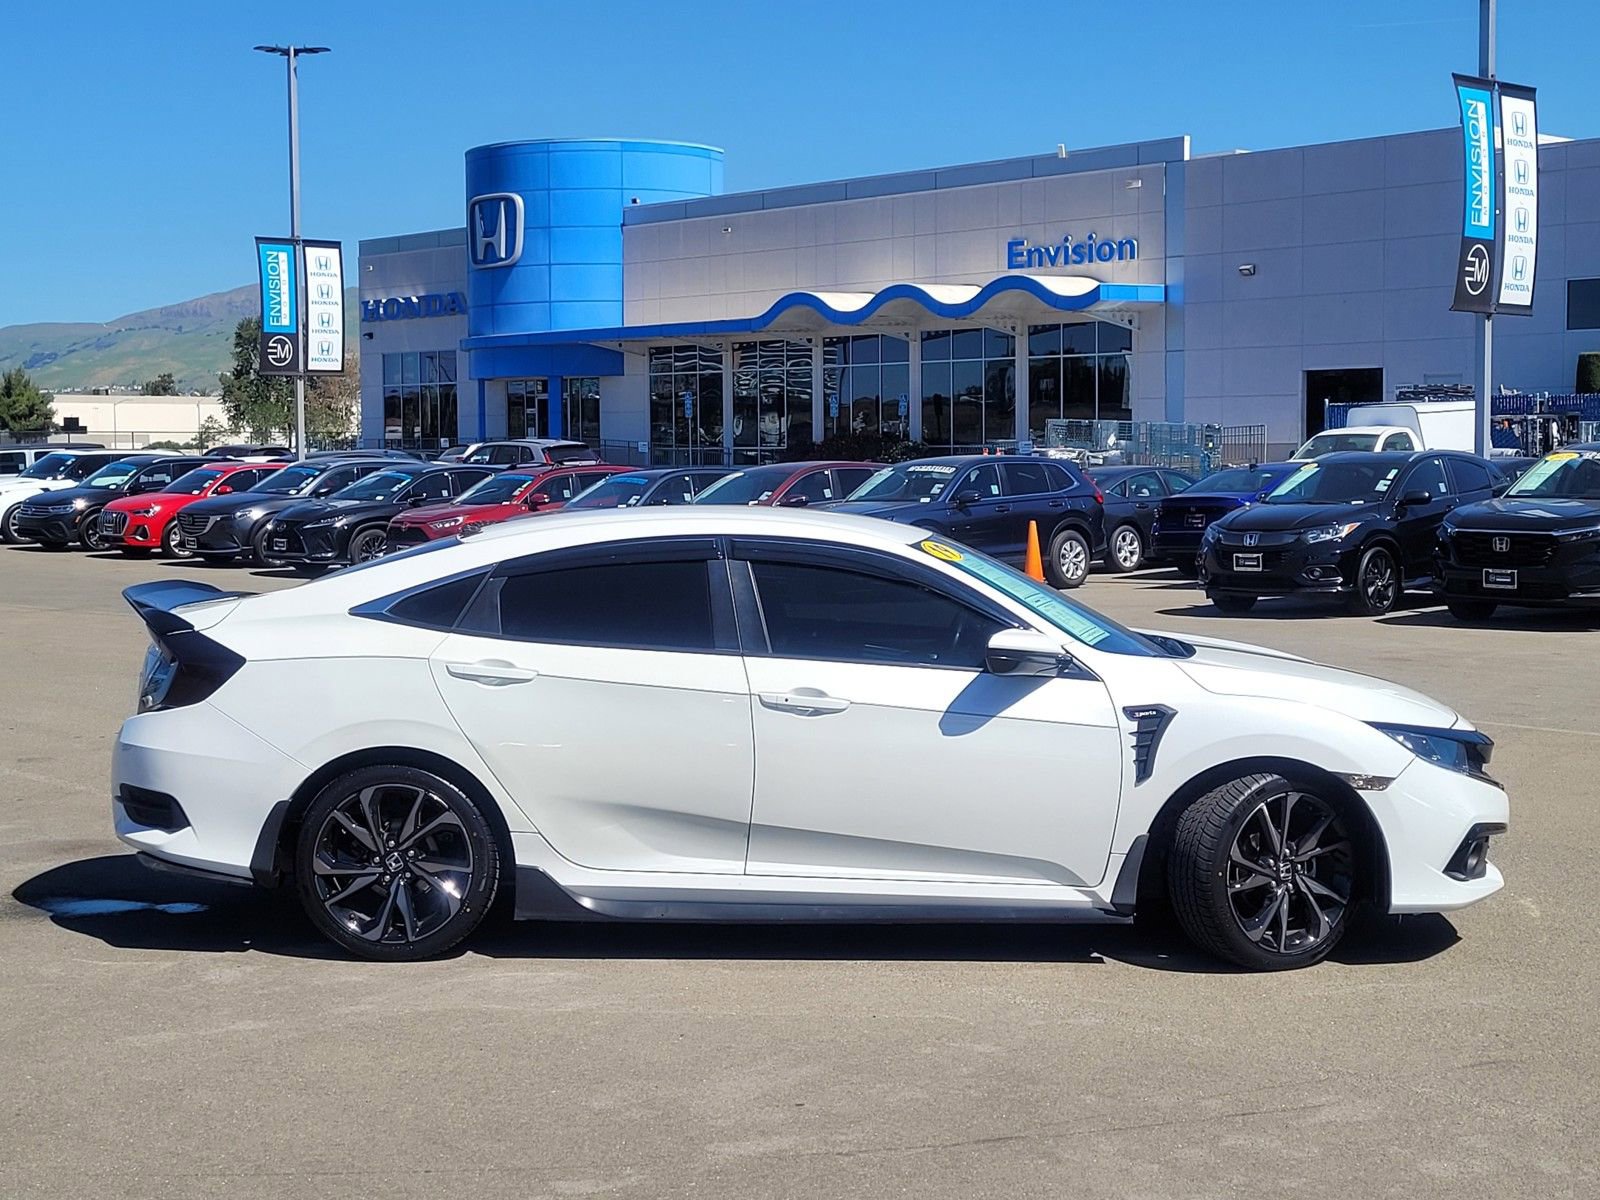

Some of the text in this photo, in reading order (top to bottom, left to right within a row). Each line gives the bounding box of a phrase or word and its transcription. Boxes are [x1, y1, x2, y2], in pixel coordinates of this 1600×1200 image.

[1506, 138, 1534, 149] HONDA
[1466, 99, 1482, 225] ENVISION
[1508, 186, 1535, 197] HONDA
[1507, 234, 1534, 245] HONDA
[1007, 232, 1138, 270] Envision
[266, 250, 281, 327] ENVISION
[1503, 282, 1530, 293] HONDA
[361, 292, 468, 322] HONDA
